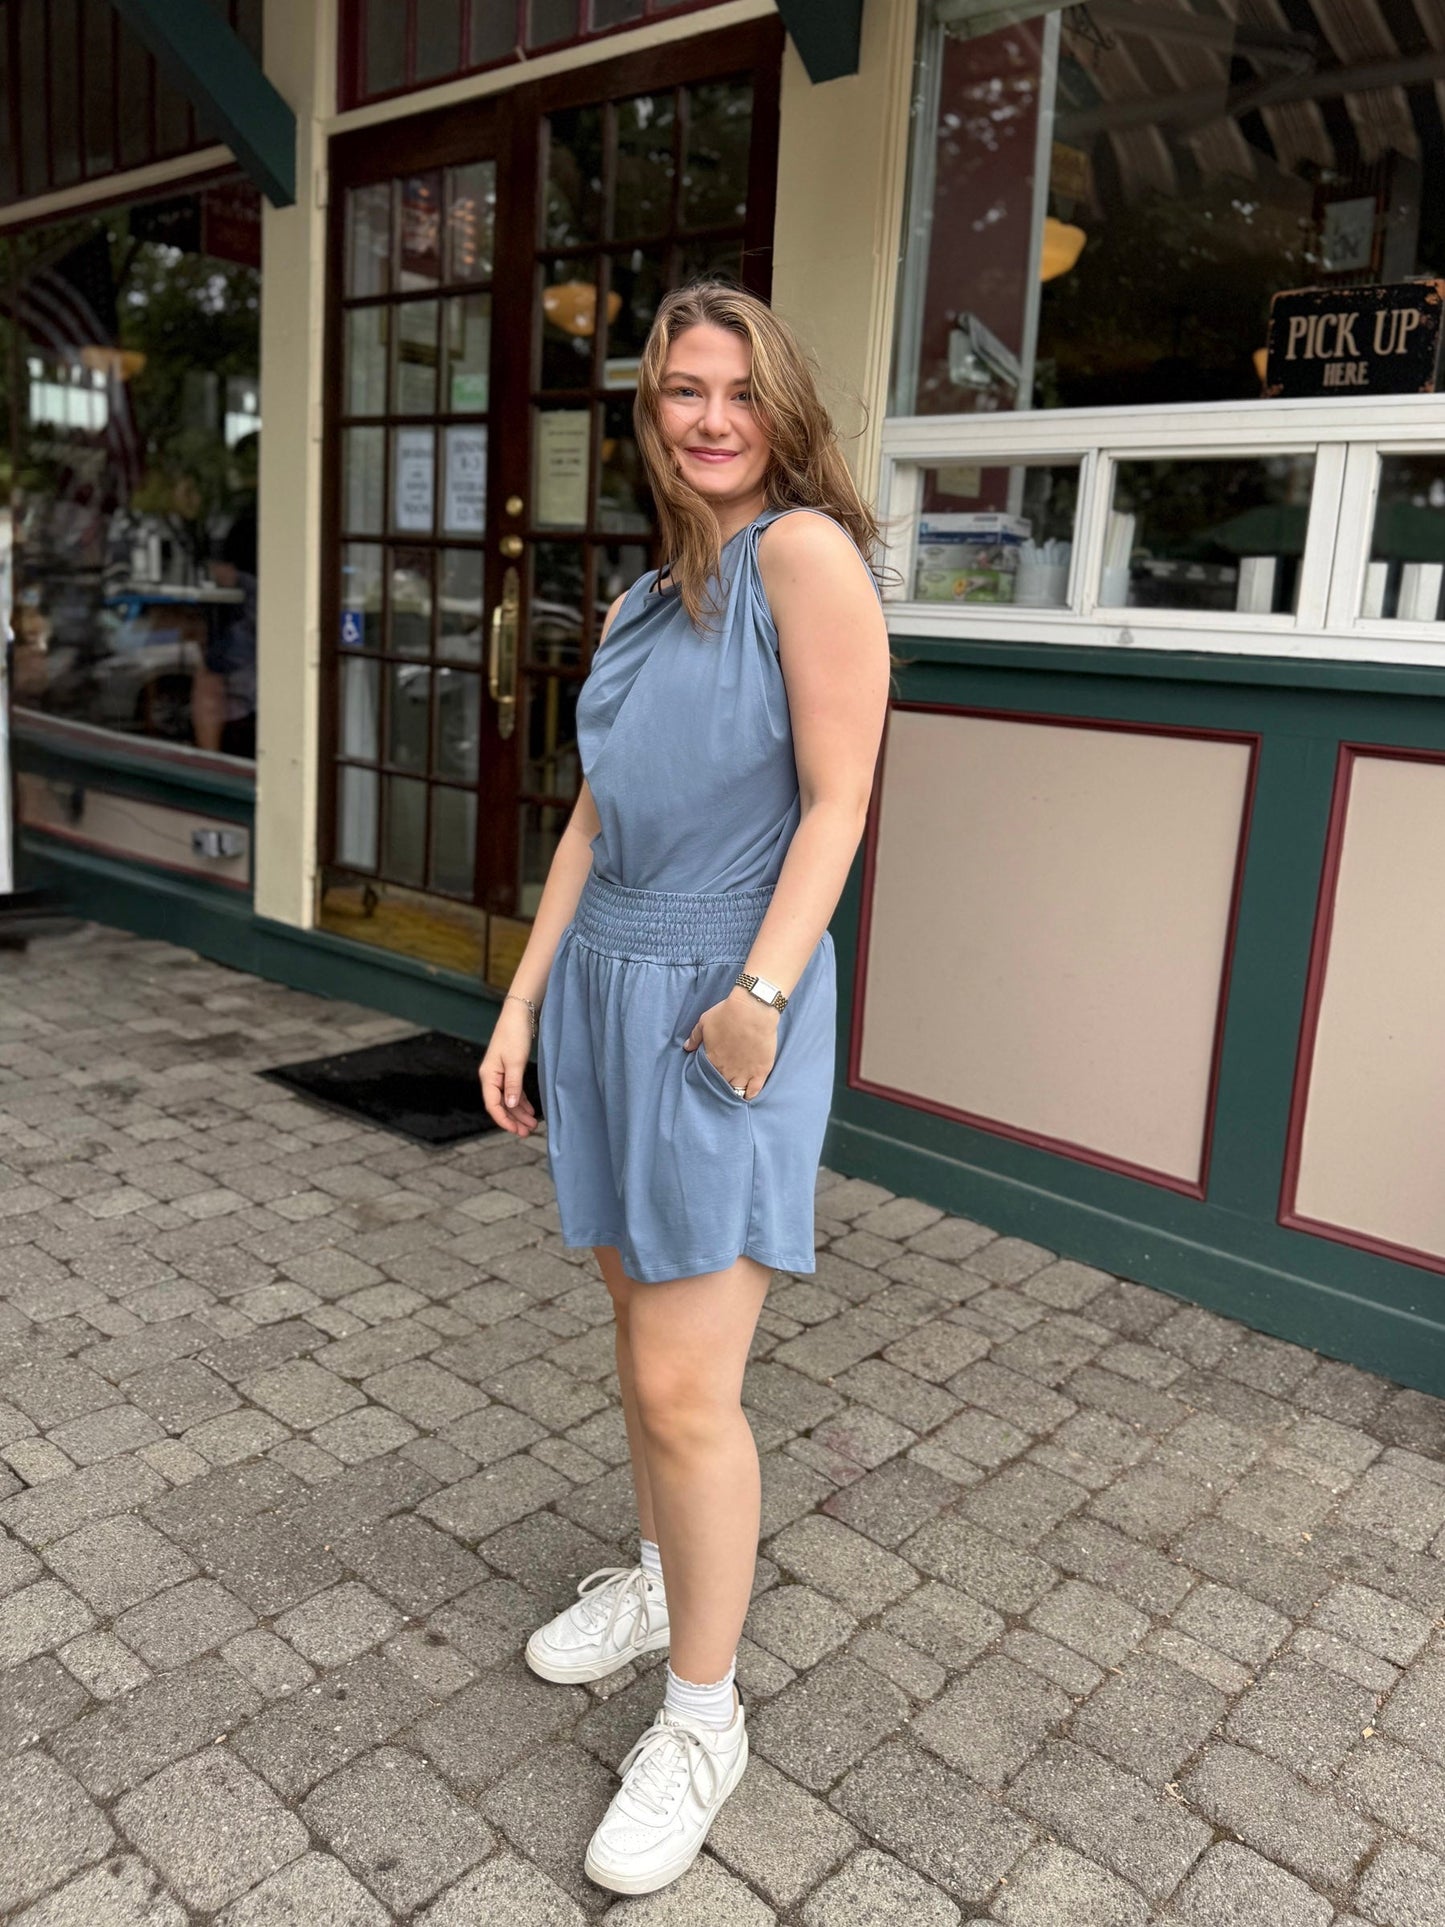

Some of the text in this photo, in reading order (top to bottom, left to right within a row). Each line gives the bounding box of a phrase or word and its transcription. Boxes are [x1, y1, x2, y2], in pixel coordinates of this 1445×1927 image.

[1285, 308, 1420, 361] PICK UP
[1322, 361, 1369, 387] HERE
